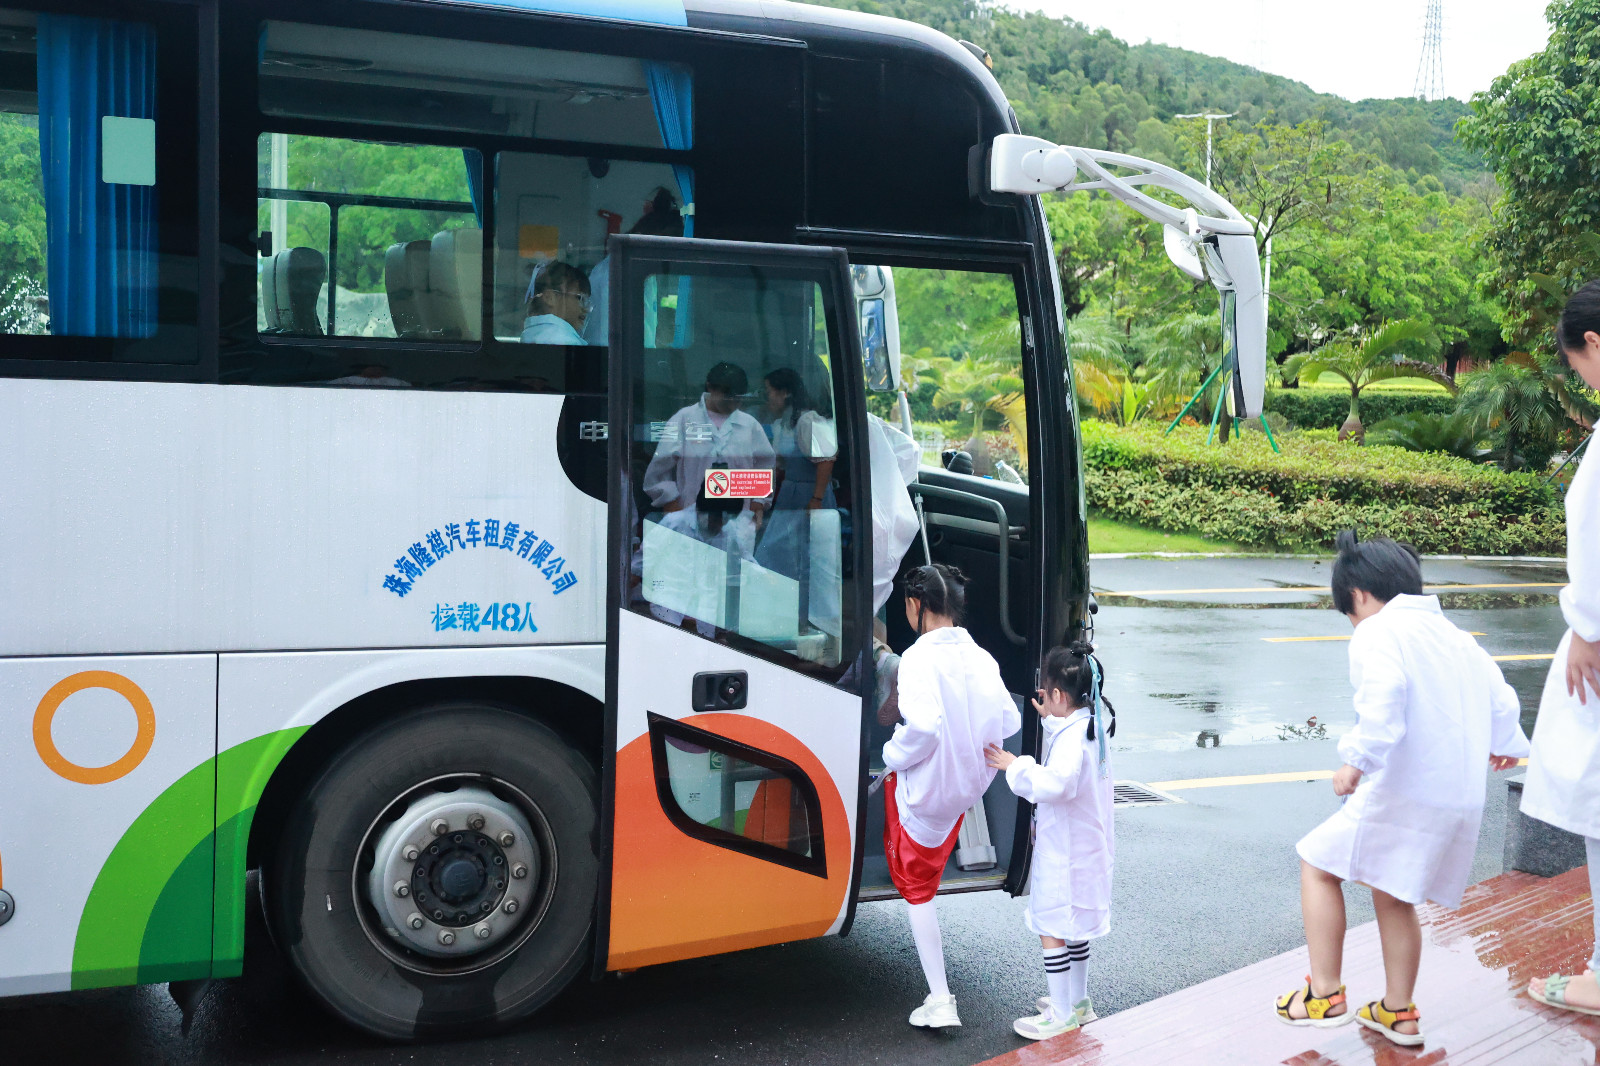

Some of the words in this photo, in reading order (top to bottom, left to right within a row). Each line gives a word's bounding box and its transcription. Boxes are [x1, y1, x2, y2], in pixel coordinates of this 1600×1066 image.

[382, 518, 578, 598] 珠海隆祺汽车租赁有限公司
[430, 601, 538, 633] 核载48人
